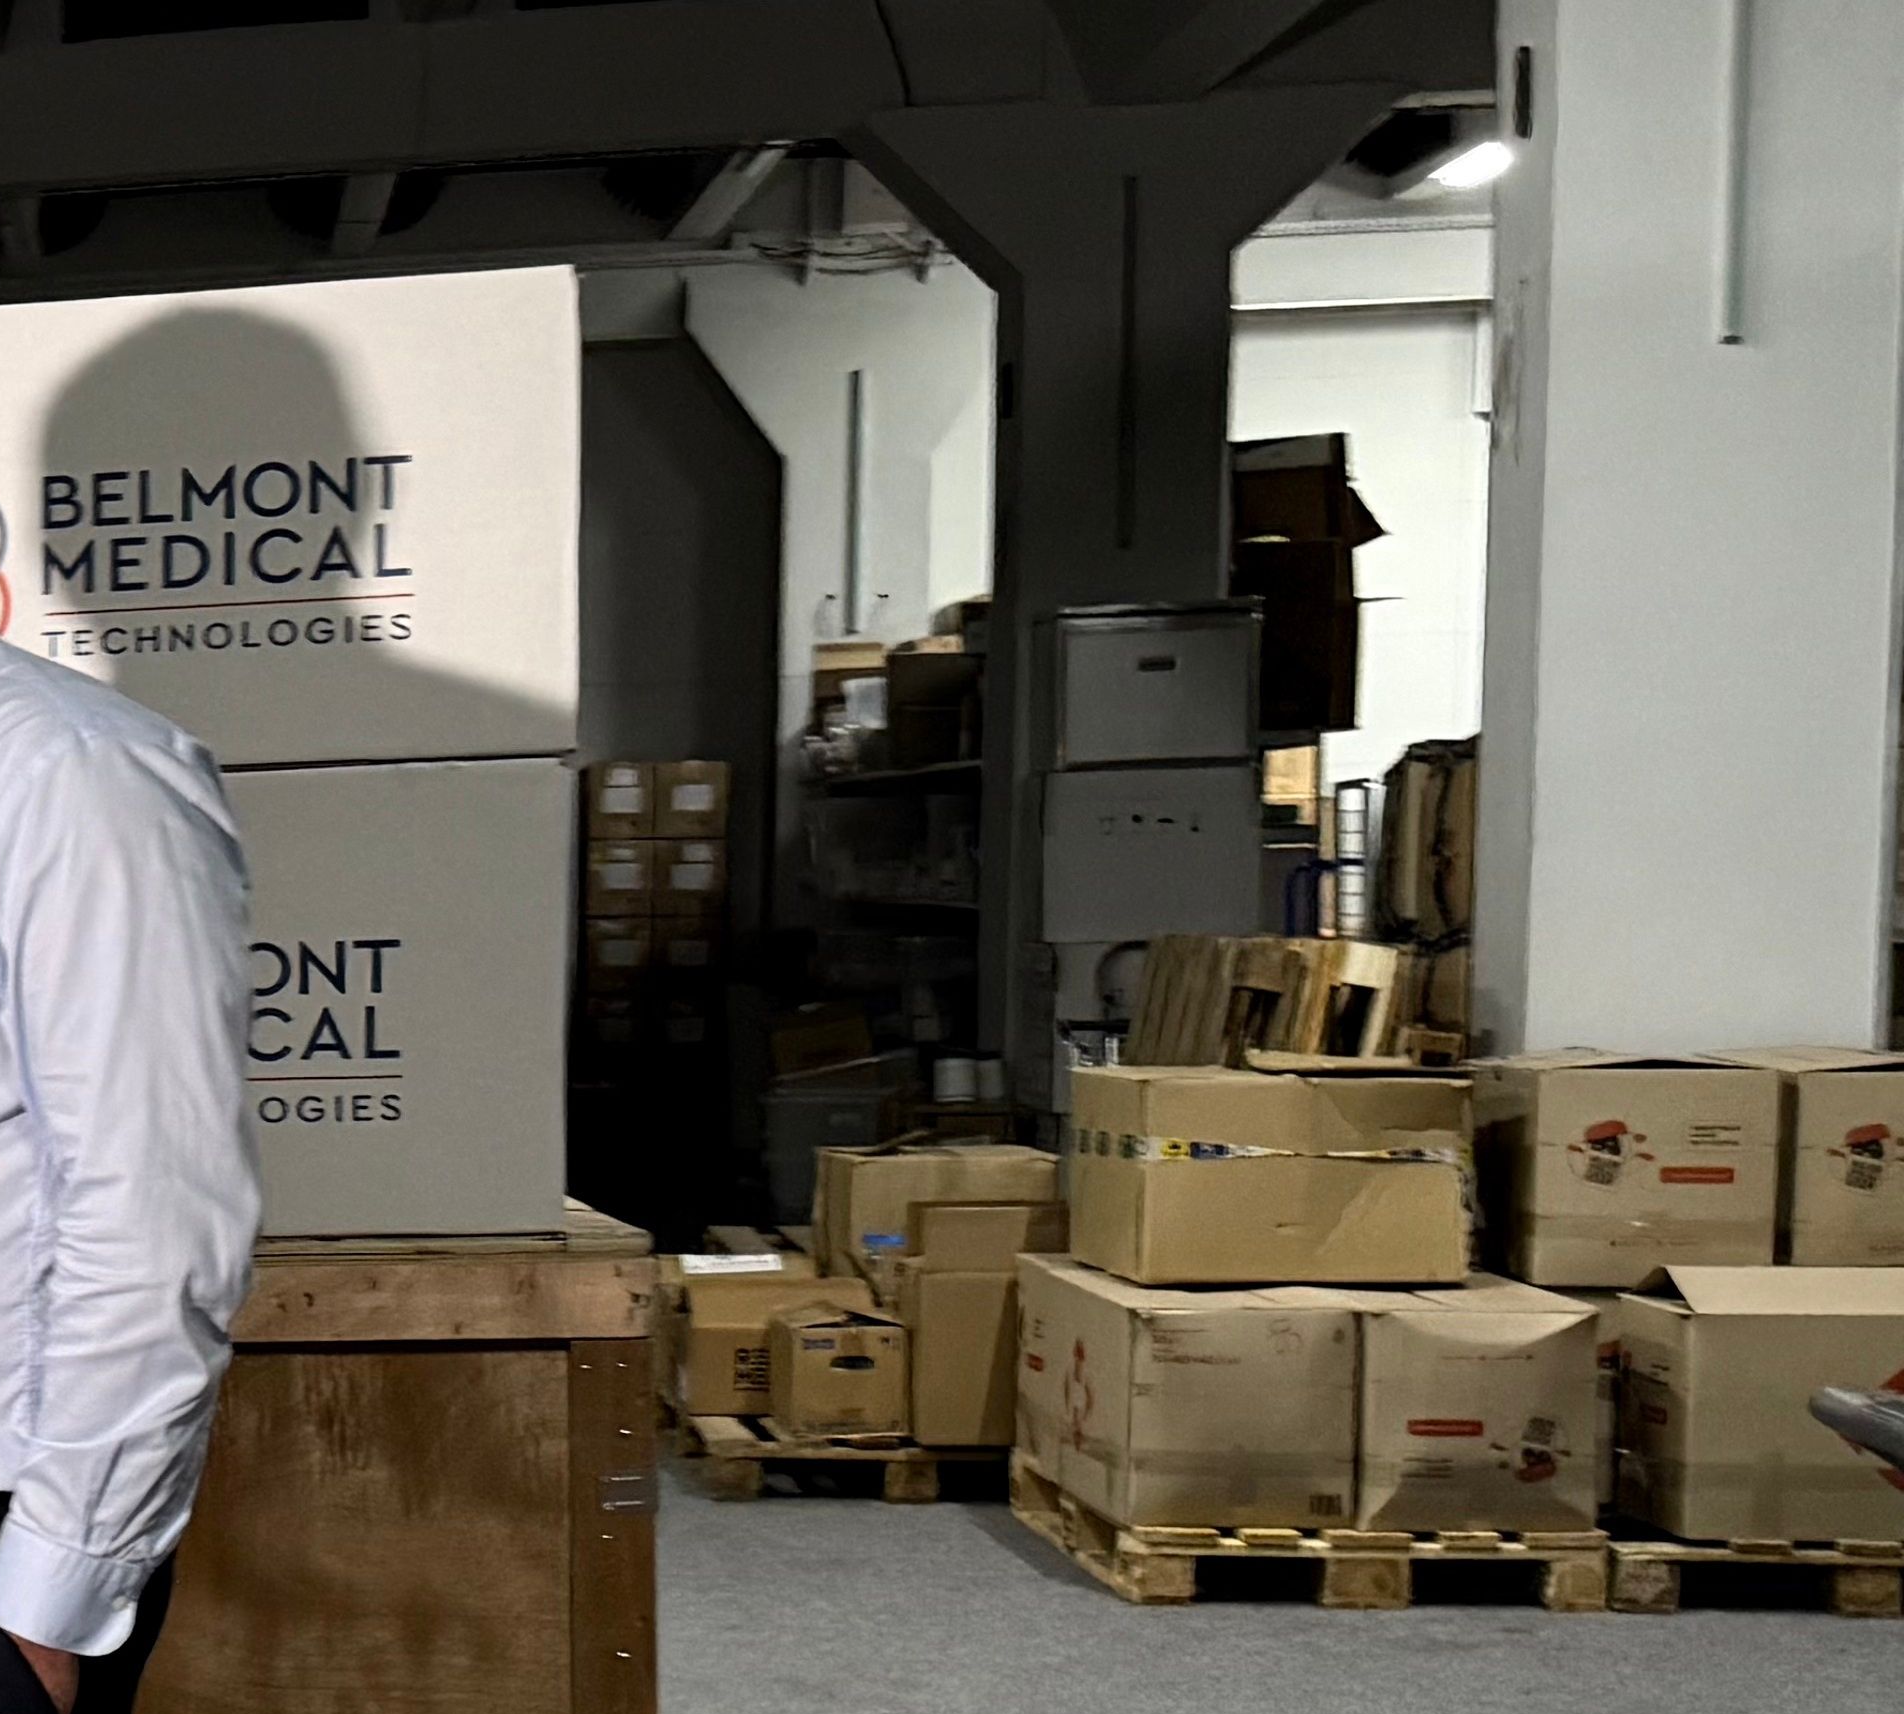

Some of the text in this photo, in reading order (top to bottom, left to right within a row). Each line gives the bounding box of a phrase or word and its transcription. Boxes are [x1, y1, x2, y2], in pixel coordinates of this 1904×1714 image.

[42, 455, 414, 530] BELMONT
[41, 523, 414, 596] MEDICAL
[40, 613, 413, 658] TECHNOLOGIES
